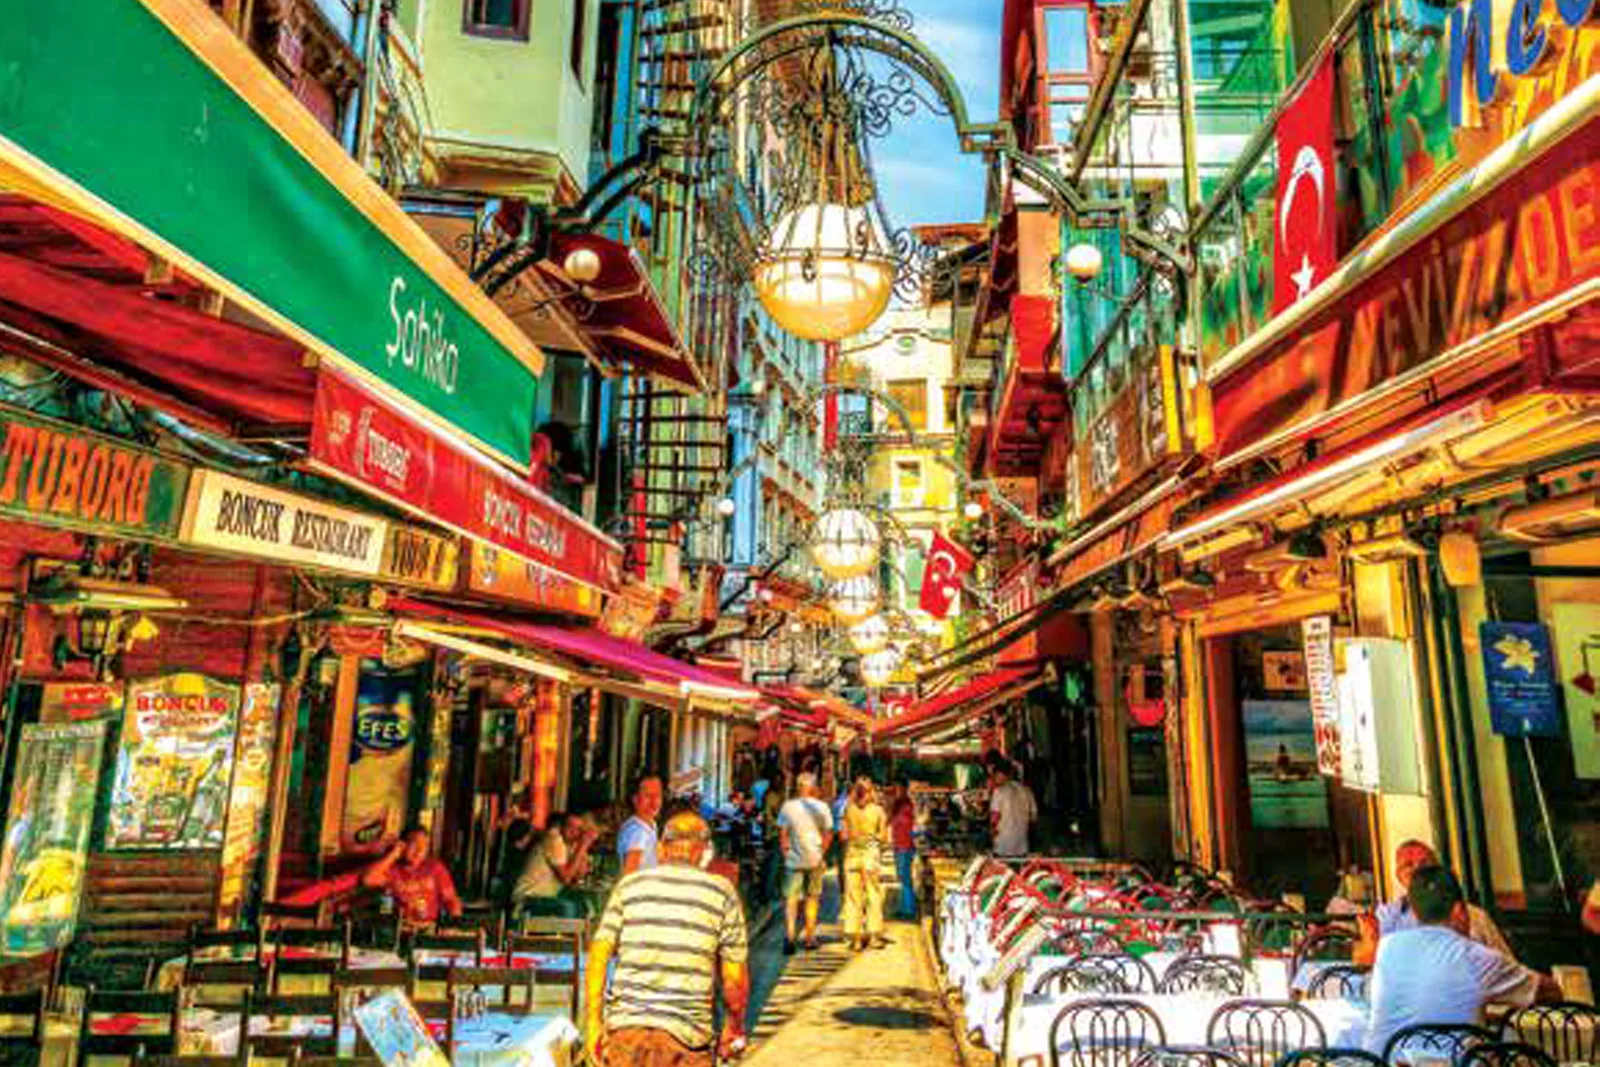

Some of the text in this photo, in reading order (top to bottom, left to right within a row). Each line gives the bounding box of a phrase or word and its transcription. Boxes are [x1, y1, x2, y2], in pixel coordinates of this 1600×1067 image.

[0, 421, 156, 525] TUBORG
[215, 489, 284, 543] BONCUK
[291, 510, 373, 561] RESTAURANT
[136, 694, 229, 715] BONCUK
[359, 718, 409, 741] EFES
